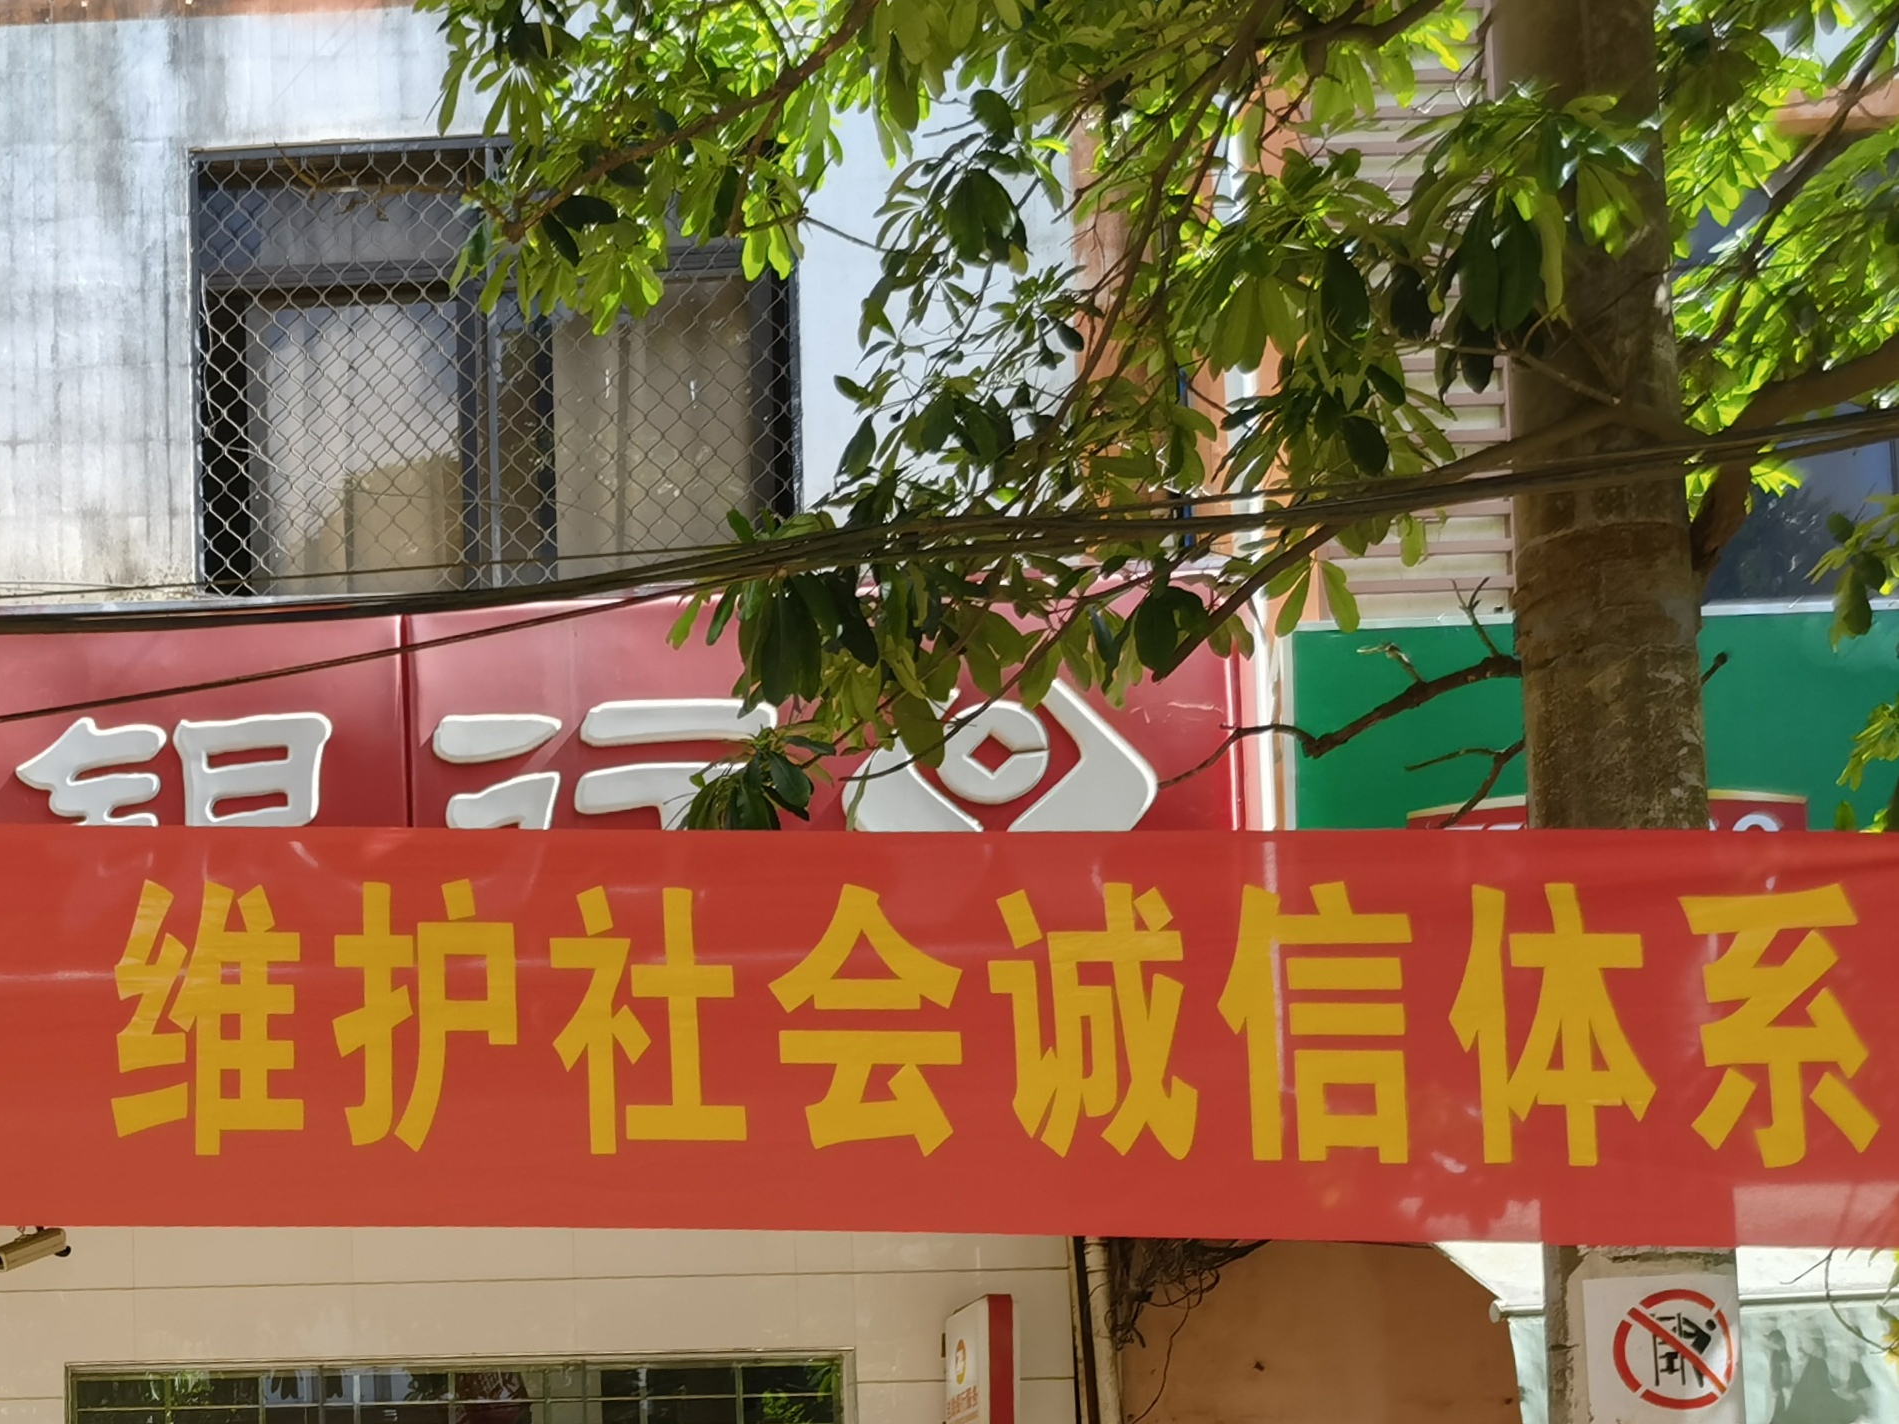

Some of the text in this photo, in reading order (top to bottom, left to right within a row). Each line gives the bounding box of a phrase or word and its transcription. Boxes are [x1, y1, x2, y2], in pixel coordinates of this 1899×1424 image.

[112, 880, 1879, 1168] 维护社会诚信体系
